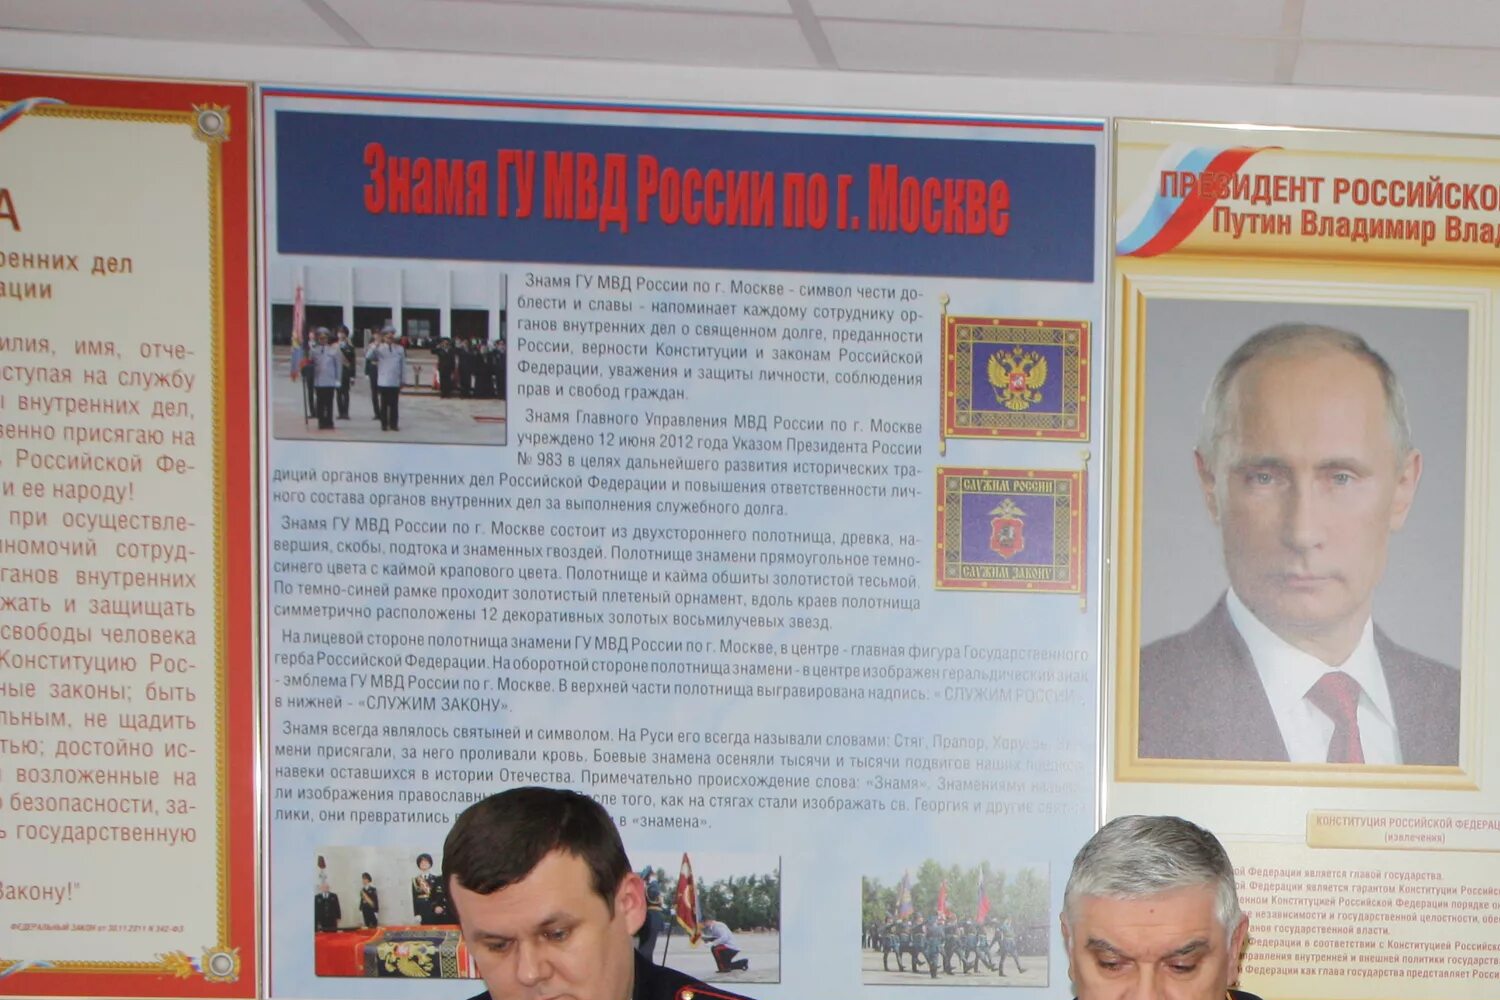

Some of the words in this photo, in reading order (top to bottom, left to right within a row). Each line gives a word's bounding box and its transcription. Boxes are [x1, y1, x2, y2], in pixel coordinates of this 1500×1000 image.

[362, 142, 488, 217] Знамя
[496, 149, 536, 218] ГУ
[543, 152, 628, 233] МВД
[637, 154, 775, 228] России
[784, 172, 825, 230] по
[836, 174, 861, 230] г.
[868, 163, 1011, 236] Москве
[1160, 170, 1325, 204] ПРЕЗИДЕНТ
[1212, 206, 1292, 238] Путин
[1300, 216, 1437, 246] Владимир
[91, 256, 132, 275] дел
[525, 272, 570, 287] Знамя
[576, 274, 592, 288] ГУ
[598, 275, 631, 292] МВД
[636, 276, 687, 292] России
[693, 281, 710, 293] по
[715, 282, 725, 293] г.
[730, 279, 783, 296] Москве
[799, 285, 851, 297] символ
[857, 287, 895, 298] чести
[900, 288, 922, 302] до-
[75, 340, 120, 359] имя,
[140, 342, 193, 359] отче-
[518, 337, 573, 354] России,
[582, 342, 647, 357] верности
[656, 342, 746, 360] Конституции
[756, 348, 763, 358] и
[772, 348, 830, 361] законам
[839, 347, 922, 364] Российской
[84, 369, 107, 385] на
[118, 368, 194, 392] службу
[18, 395, 139, 416] внутренних
[151, 400, 193, 419] дел,
[63, 426, 164, 446] присягаю
[172, 430, 195, 446] на
[517, 433, 594, 447] учреждено
[599, 432, 614, 446] 12
[619, 436, 655, 447] июня
[660, 433, 692, 448] 2012
[697, 438, 728, 452] года
[732, 436, 782, 451] Указом
[786, 437, 867, 455] Президента
[872, 439, 921, 455] России
[16, 448, 141, 472] Российской
[156, 454, 194, 474] Фе-
[2, 481, 14, 496] и
[22, 482, 44, 498] ее
[53, 481, 132, 504] народу!
[116, 542, 195, 563] сотруд-
[76, 570, 195, 590] внутренних
[64, 598, 75, 612] и
[89, 599, 195, 619] защищать
[101, 628, 196, 645] человека
[150, 654, 195, 673] Рос-
[49, 683, 131, 702] законы;
[145, 682, 195, 701] быть
[275, 696, 281, 707] в
[288, 696, 341, 708] нижней
[358, 695, 435, 710] «СЛУЖИМ
[441, 697, 511, 712] ЗАКОНУ».
[84, 712, 107, 728] не
[119, 713, 196, 732] щадить
[54, 739, 153, 758] достойно
[164, 743, 195, 758] ис-
[16, 768, 158, 785] возложенные
[174, 771, 196, 786] на
[275, 766, 324, 778] навеки
[330, 767, 415, 780] оставшихся
[422, 769, 428, 780] в
[435, 770, 493, 784] истории
[499, 768, 575, 784] Отечества.
[581, 769, 692, 786] Примечательно
[10, 794, 159, 816] безопасности,
[166, 799, 195, 814] за-
[1315, 815, 1386, 828] КОНСТИТУЦИЯ
[1389, 816, 1452, 829] РОССИЙСКОЙ
[16, 824, 196, 846] государственную
